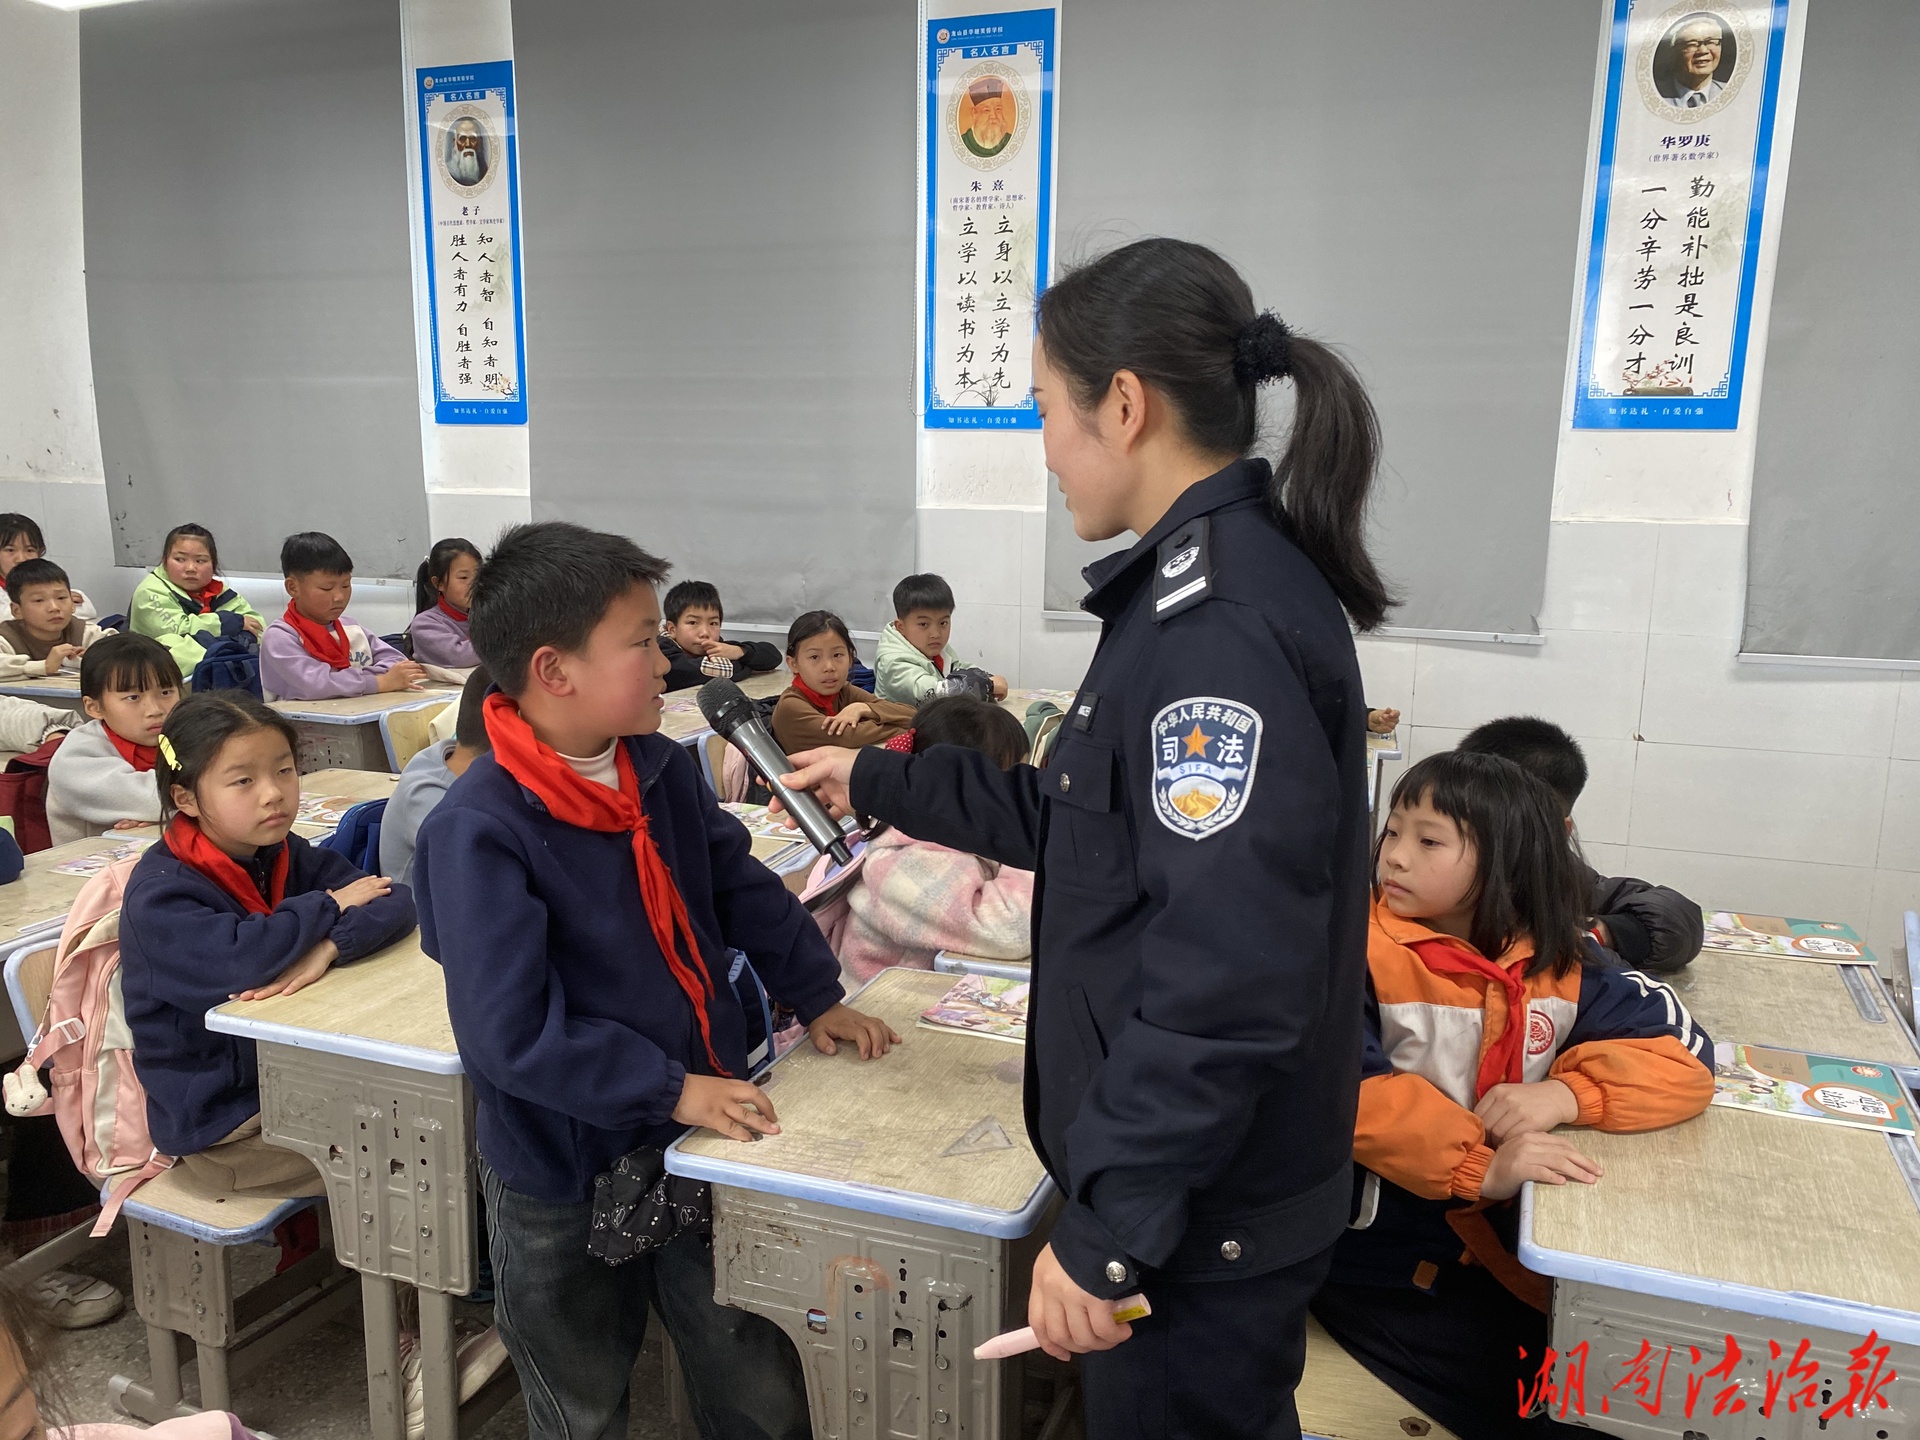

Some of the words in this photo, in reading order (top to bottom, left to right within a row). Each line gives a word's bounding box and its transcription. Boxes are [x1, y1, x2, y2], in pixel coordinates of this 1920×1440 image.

[970, 46, 1010, 57] 名人名言
[450, 91, 480, 101] 名人名言
[1660, 134, 1711, 149] 华罗庚
[449, 233, 469, 313] 胜人者有力
[476, 232, 495, 303] 知人者智
[1623, 185, 1669, 375] 一分辛劳一分才
[1668, 176, 1716, 375] 勤能补拙是良训
[955, 215, 978, 389] 立学以读书为本
[990, 214, 1014, 390] 立身以立学为先
[454, 323, 473, 385] 自胜者强
[481, 317, 499, 386] 自知者明
[149, 594, 179, 632] SPORTS
[1158, 704, 1254, 736] 中华人民共和国
[1179, 763, 1213, 775] SIFA
